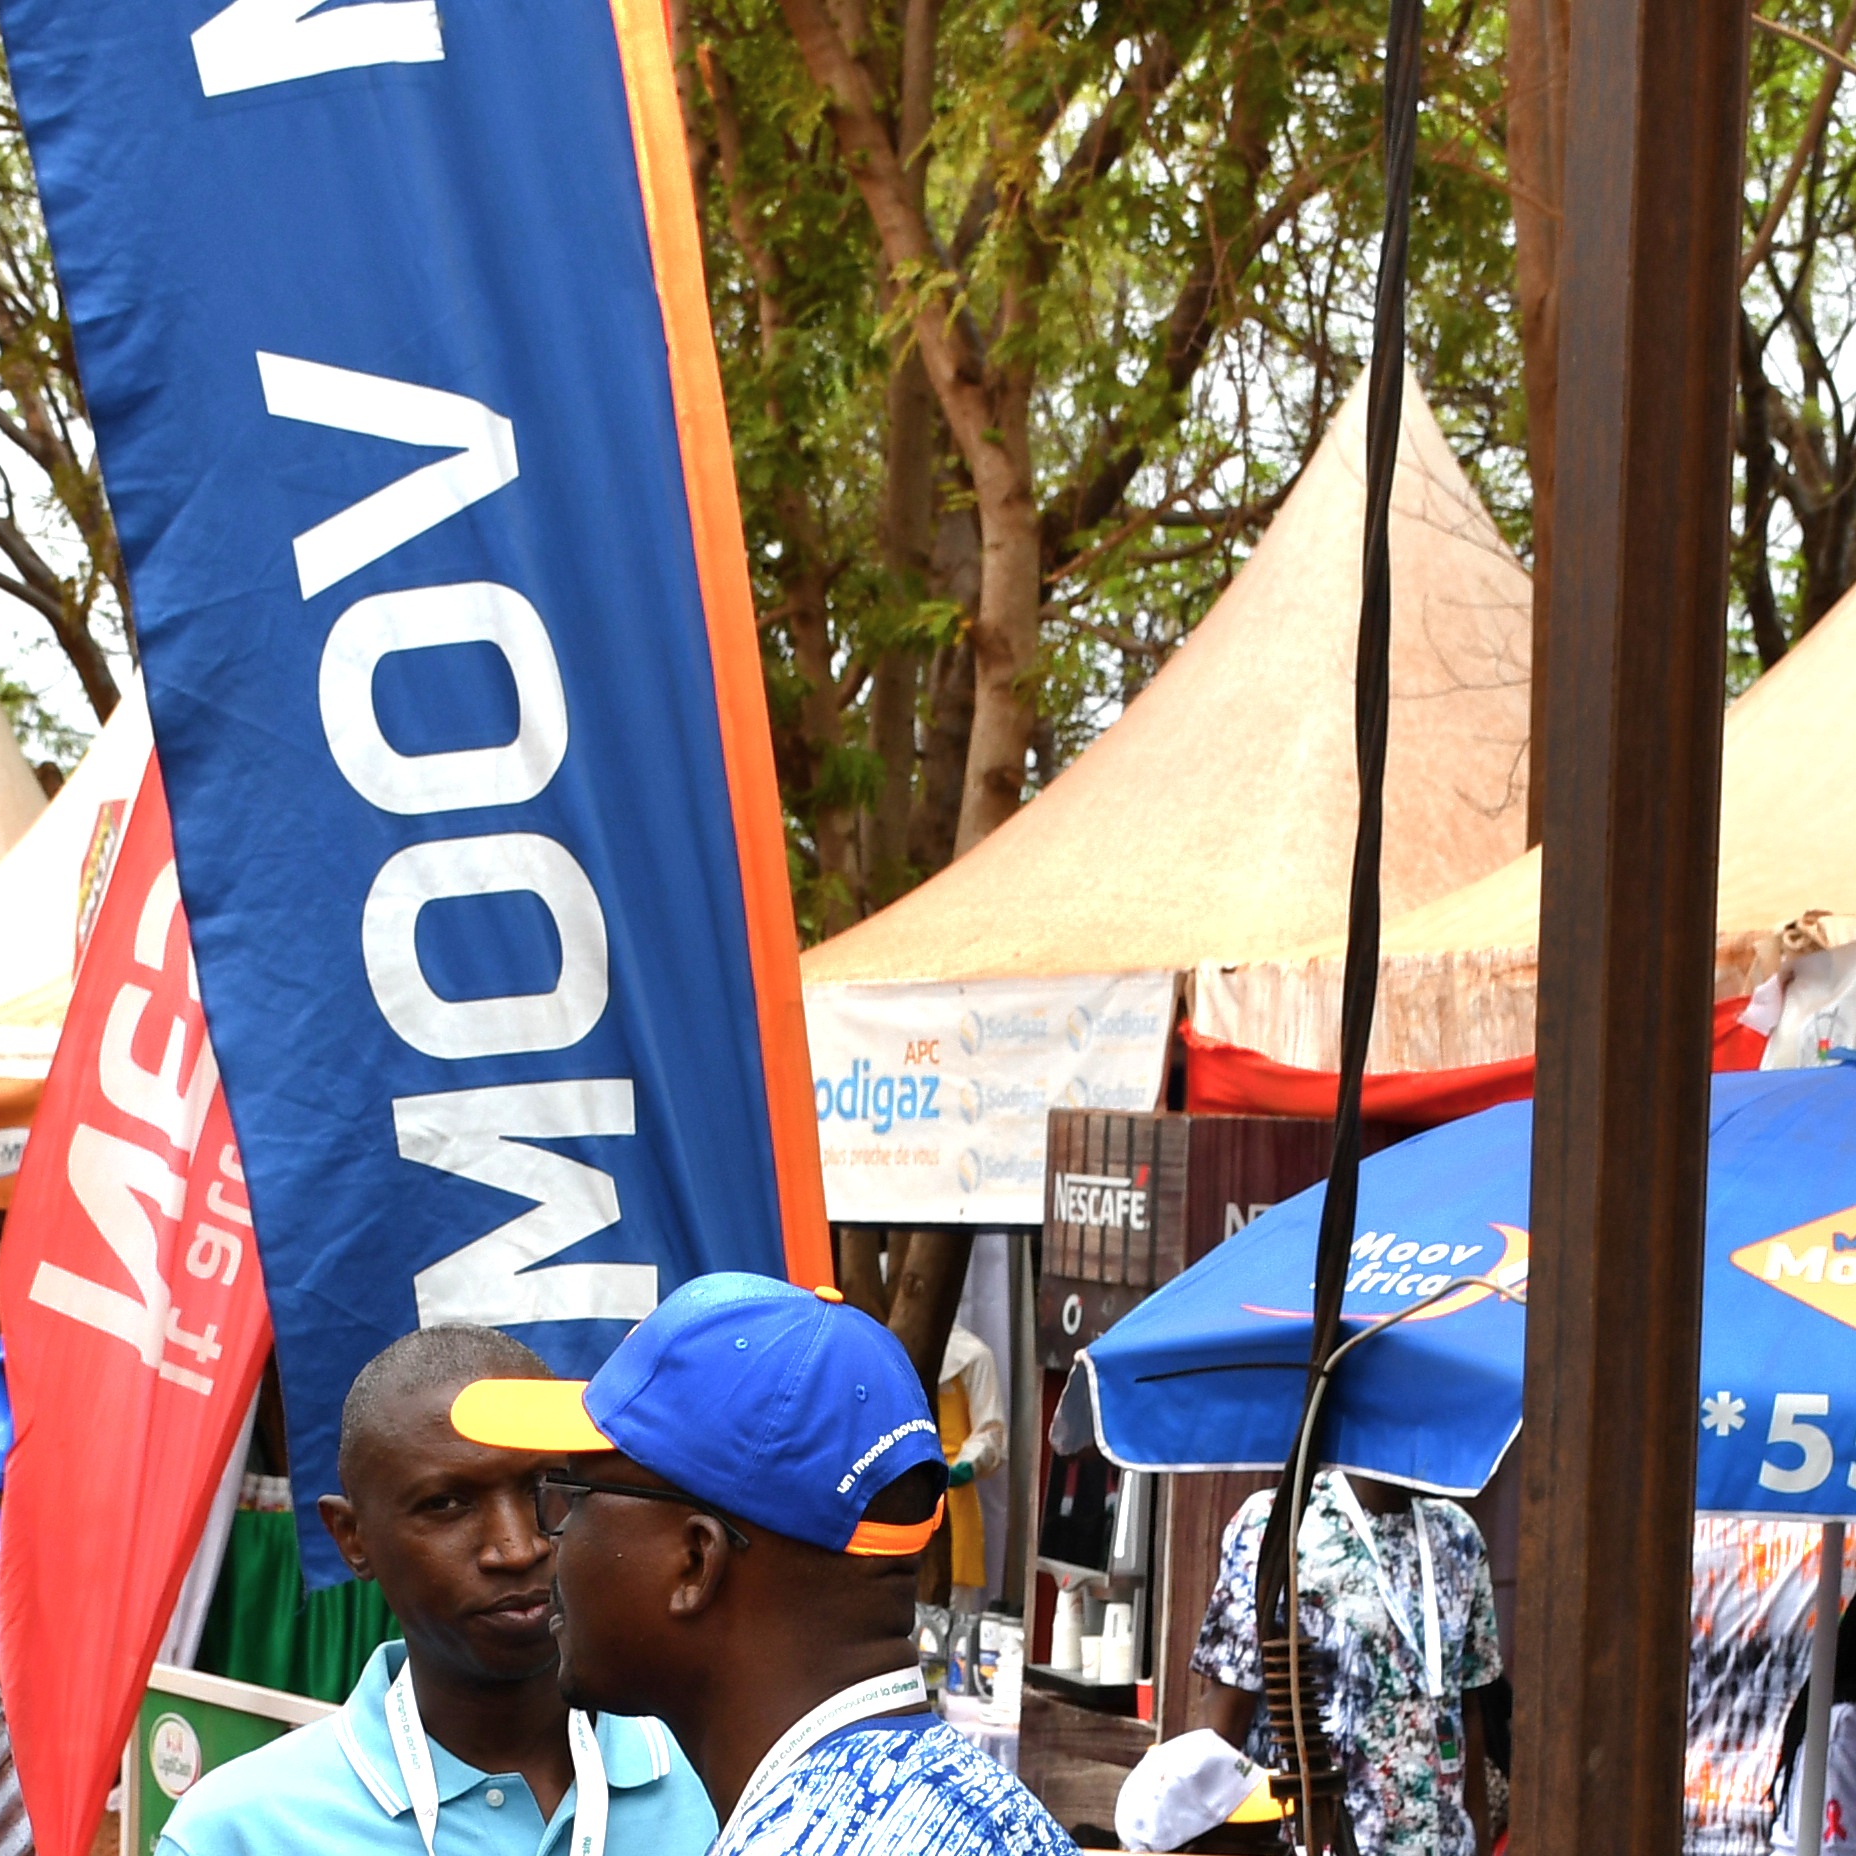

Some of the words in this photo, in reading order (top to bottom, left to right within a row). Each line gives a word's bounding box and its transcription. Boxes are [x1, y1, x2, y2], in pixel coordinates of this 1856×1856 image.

[256, 351, 658, 1327] MOOV
[904, 1039, 940, 1066] APC
[1351, 1231, 1483, 1266] Moov
[1309, 1261, 1453, 1297] frica
[837, 1473, 855, 1494] un
[852, 1434, 894, 1475] monde
[879, 1686, 891, 1697] la
